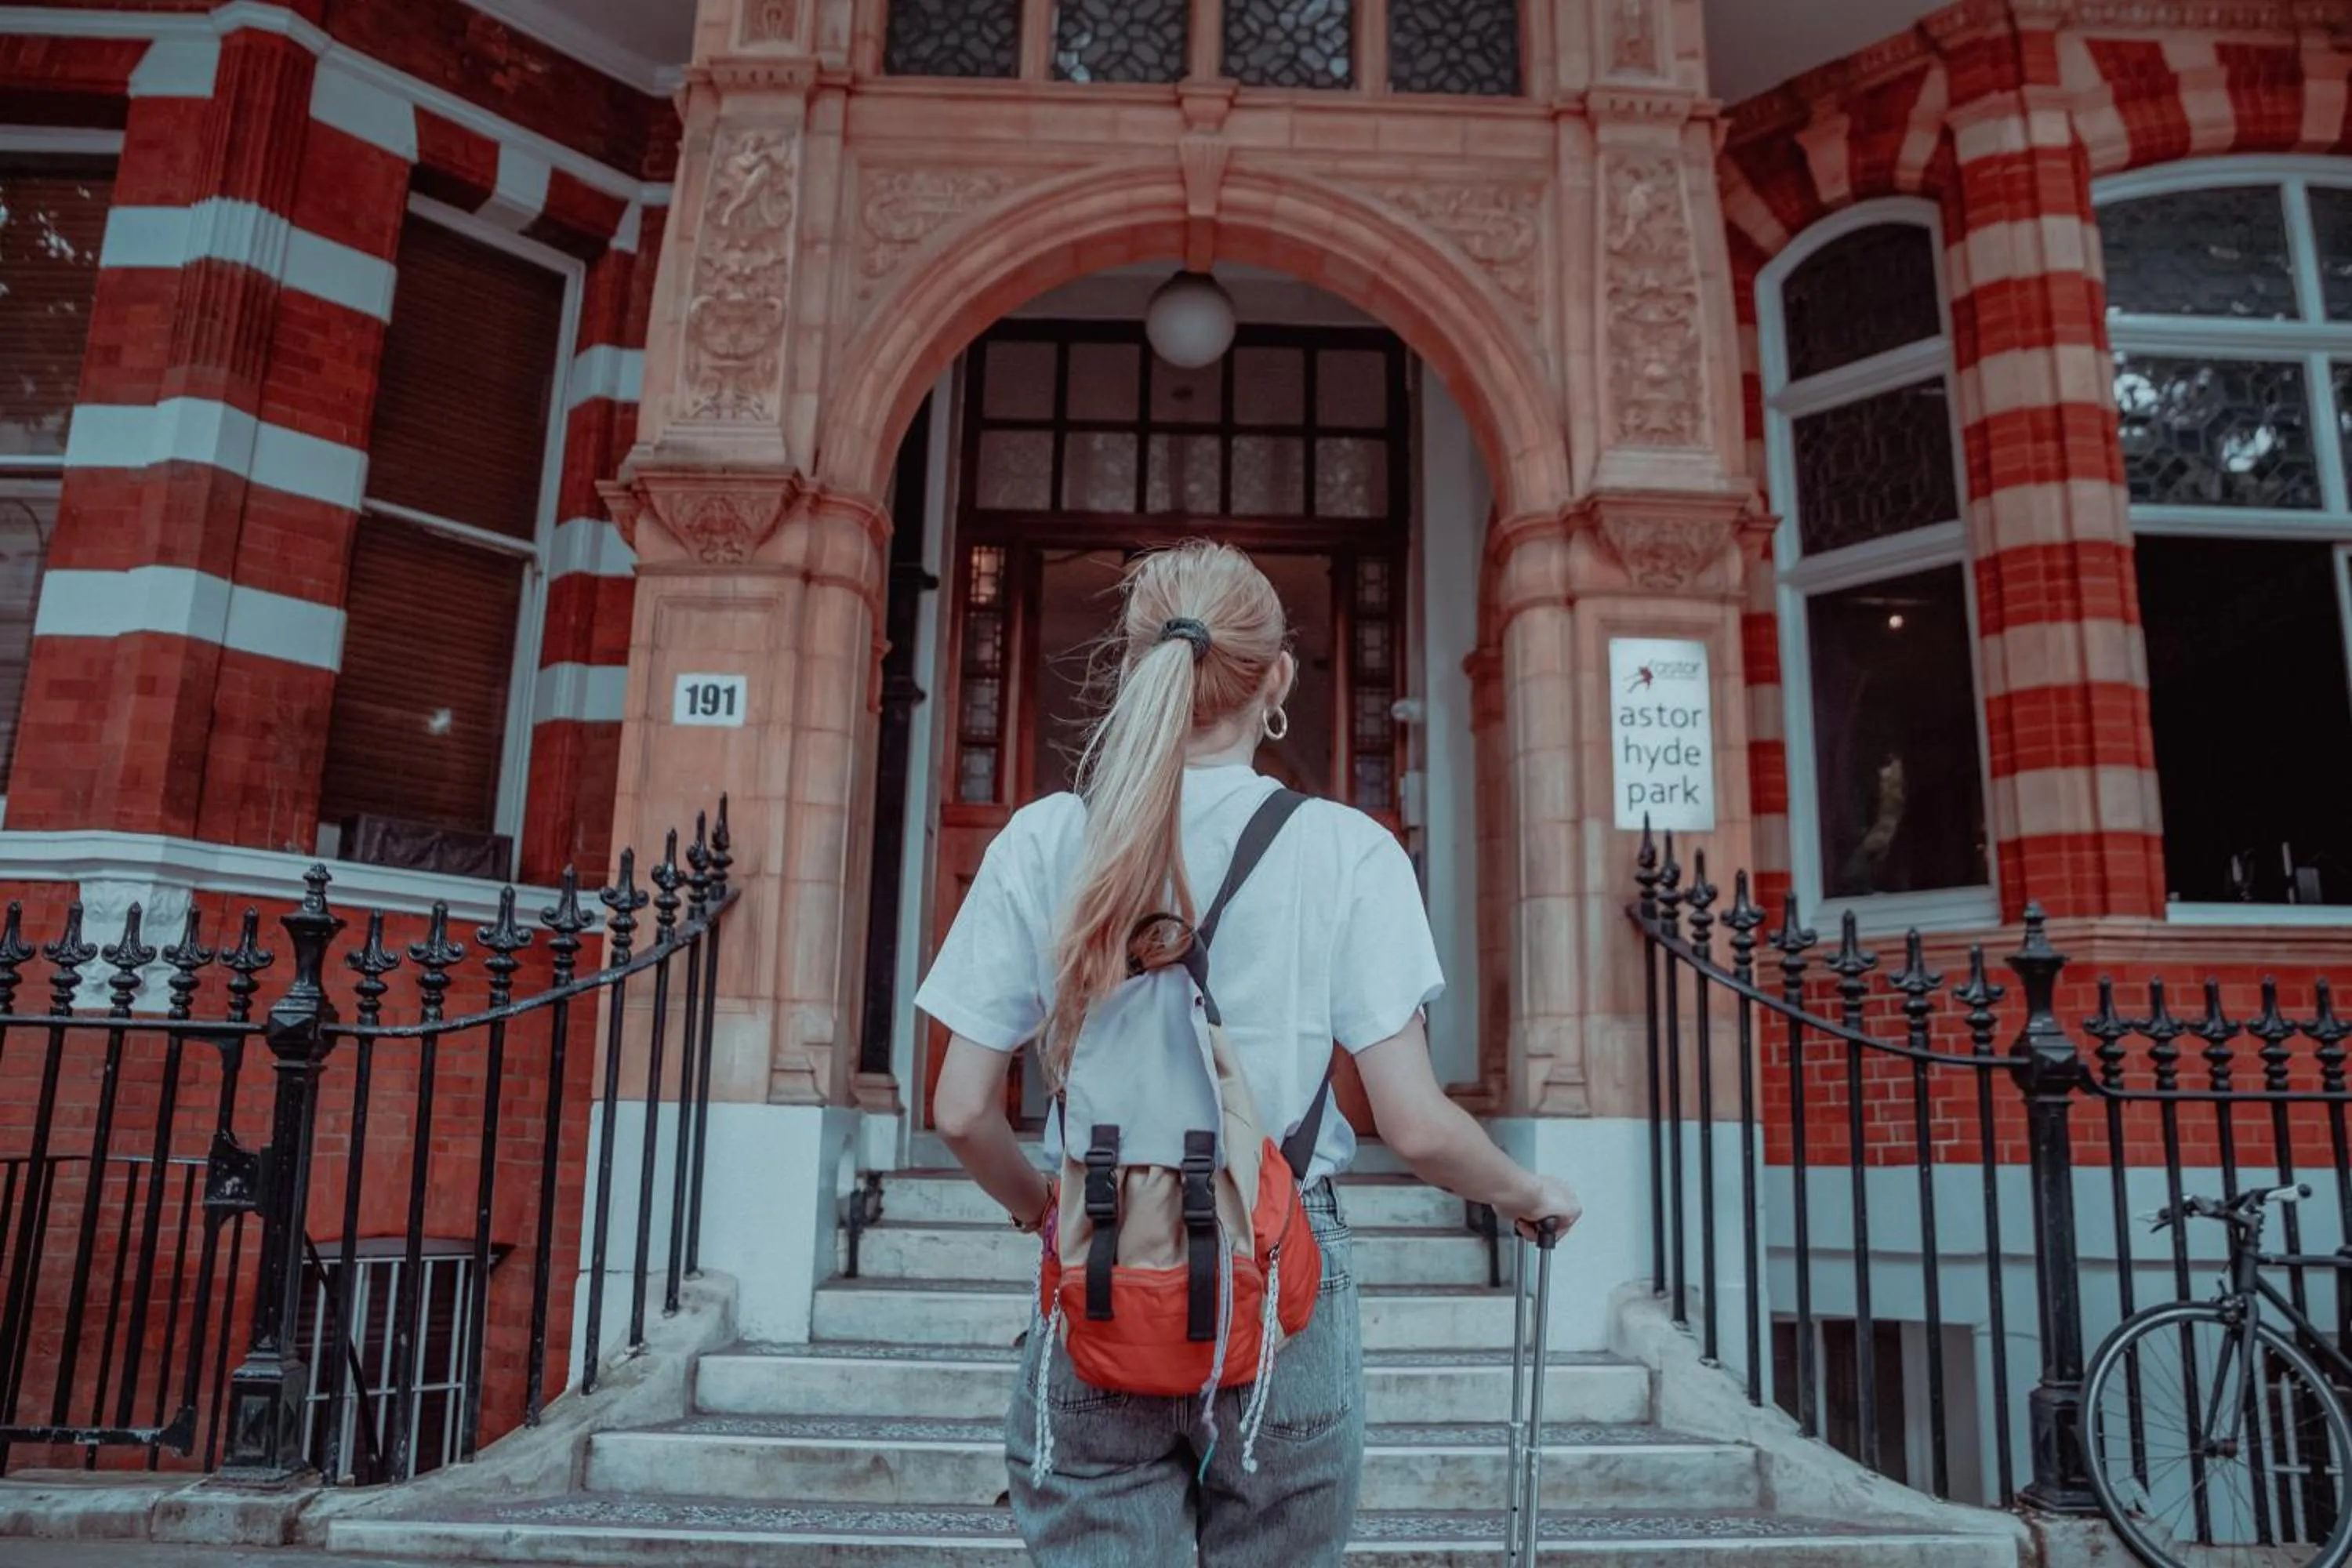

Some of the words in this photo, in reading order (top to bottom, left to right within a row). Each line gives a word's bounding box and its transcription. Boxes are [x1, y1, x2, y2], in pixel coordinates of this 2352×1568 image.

[685, 684, 736, 716] 191
[1619, 703, 1702, 728] astor
[1624, 735, 1701, 773] hyde
[1627, 775, 1700, 811] park
